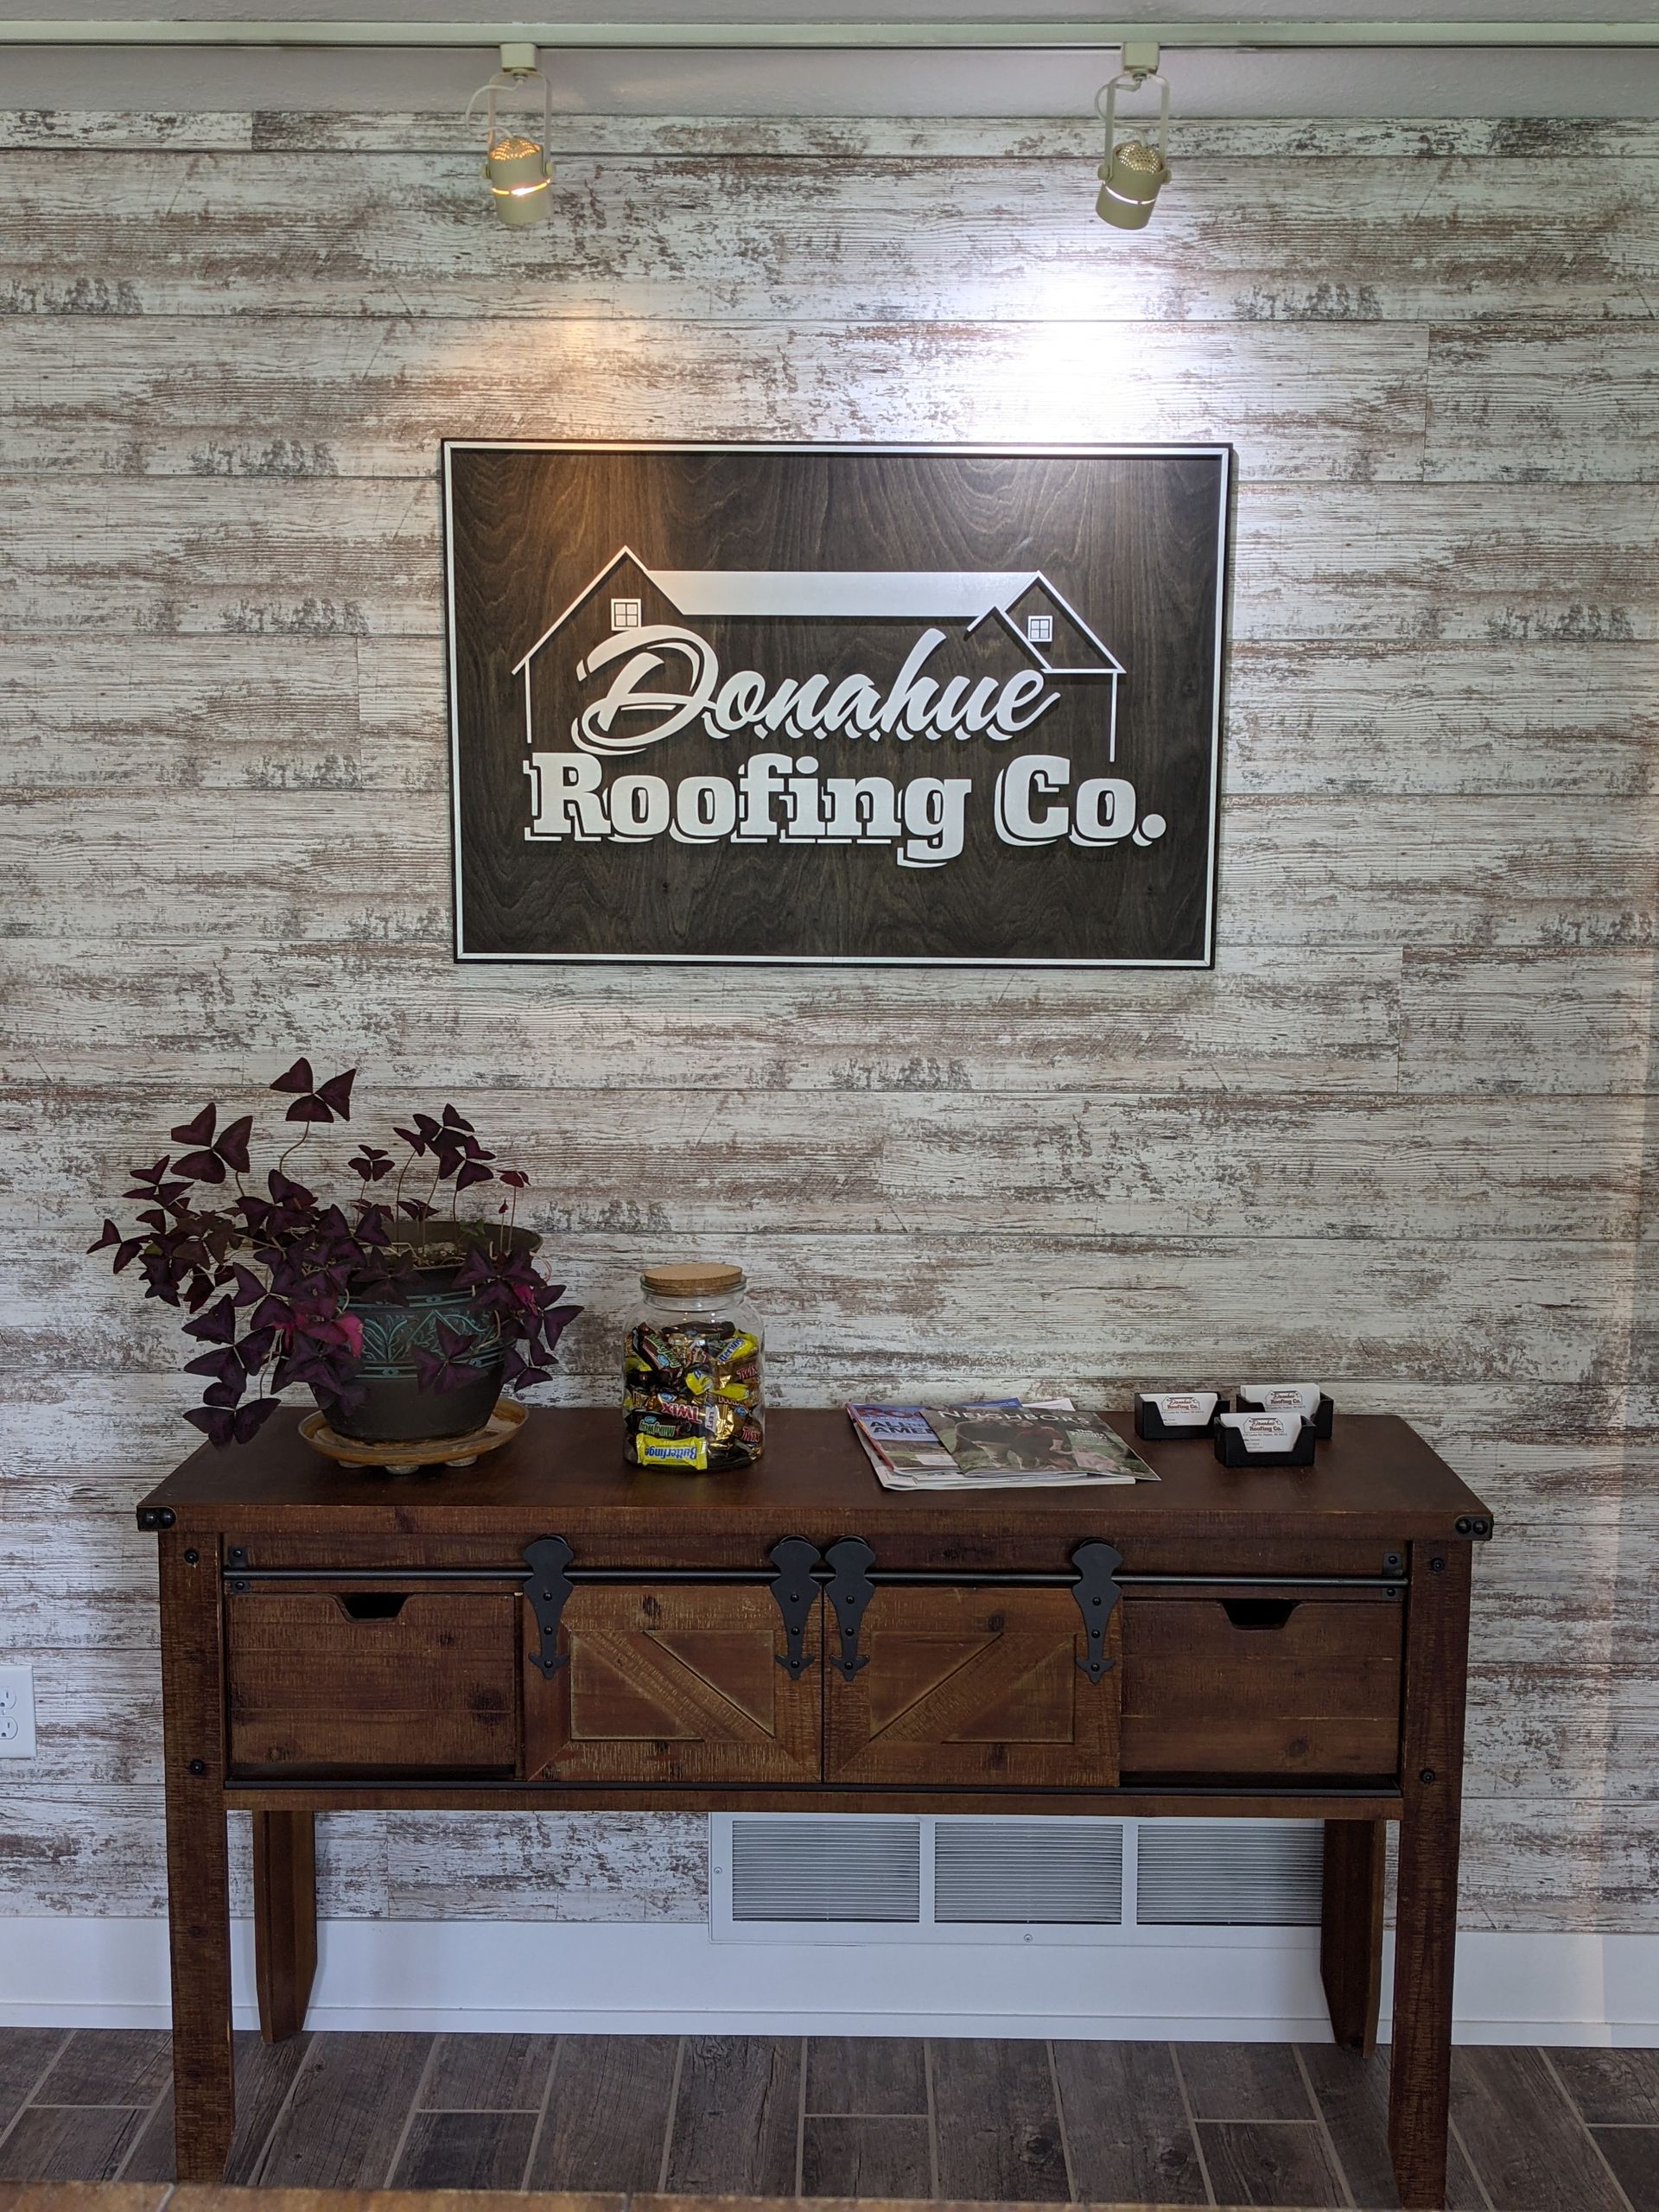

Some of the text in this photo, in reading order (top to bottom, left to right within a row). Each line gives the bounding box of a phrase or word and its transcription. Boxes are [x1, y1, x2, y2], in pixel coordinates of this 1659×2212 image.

[571, 625, 1061, 755] Donahue
[523, 752, 1166, 868] Roofing Co.
[706, 1411, 715, 1430] LEFT
[938, 1408, 1091, 1425] NEIGHBORS
